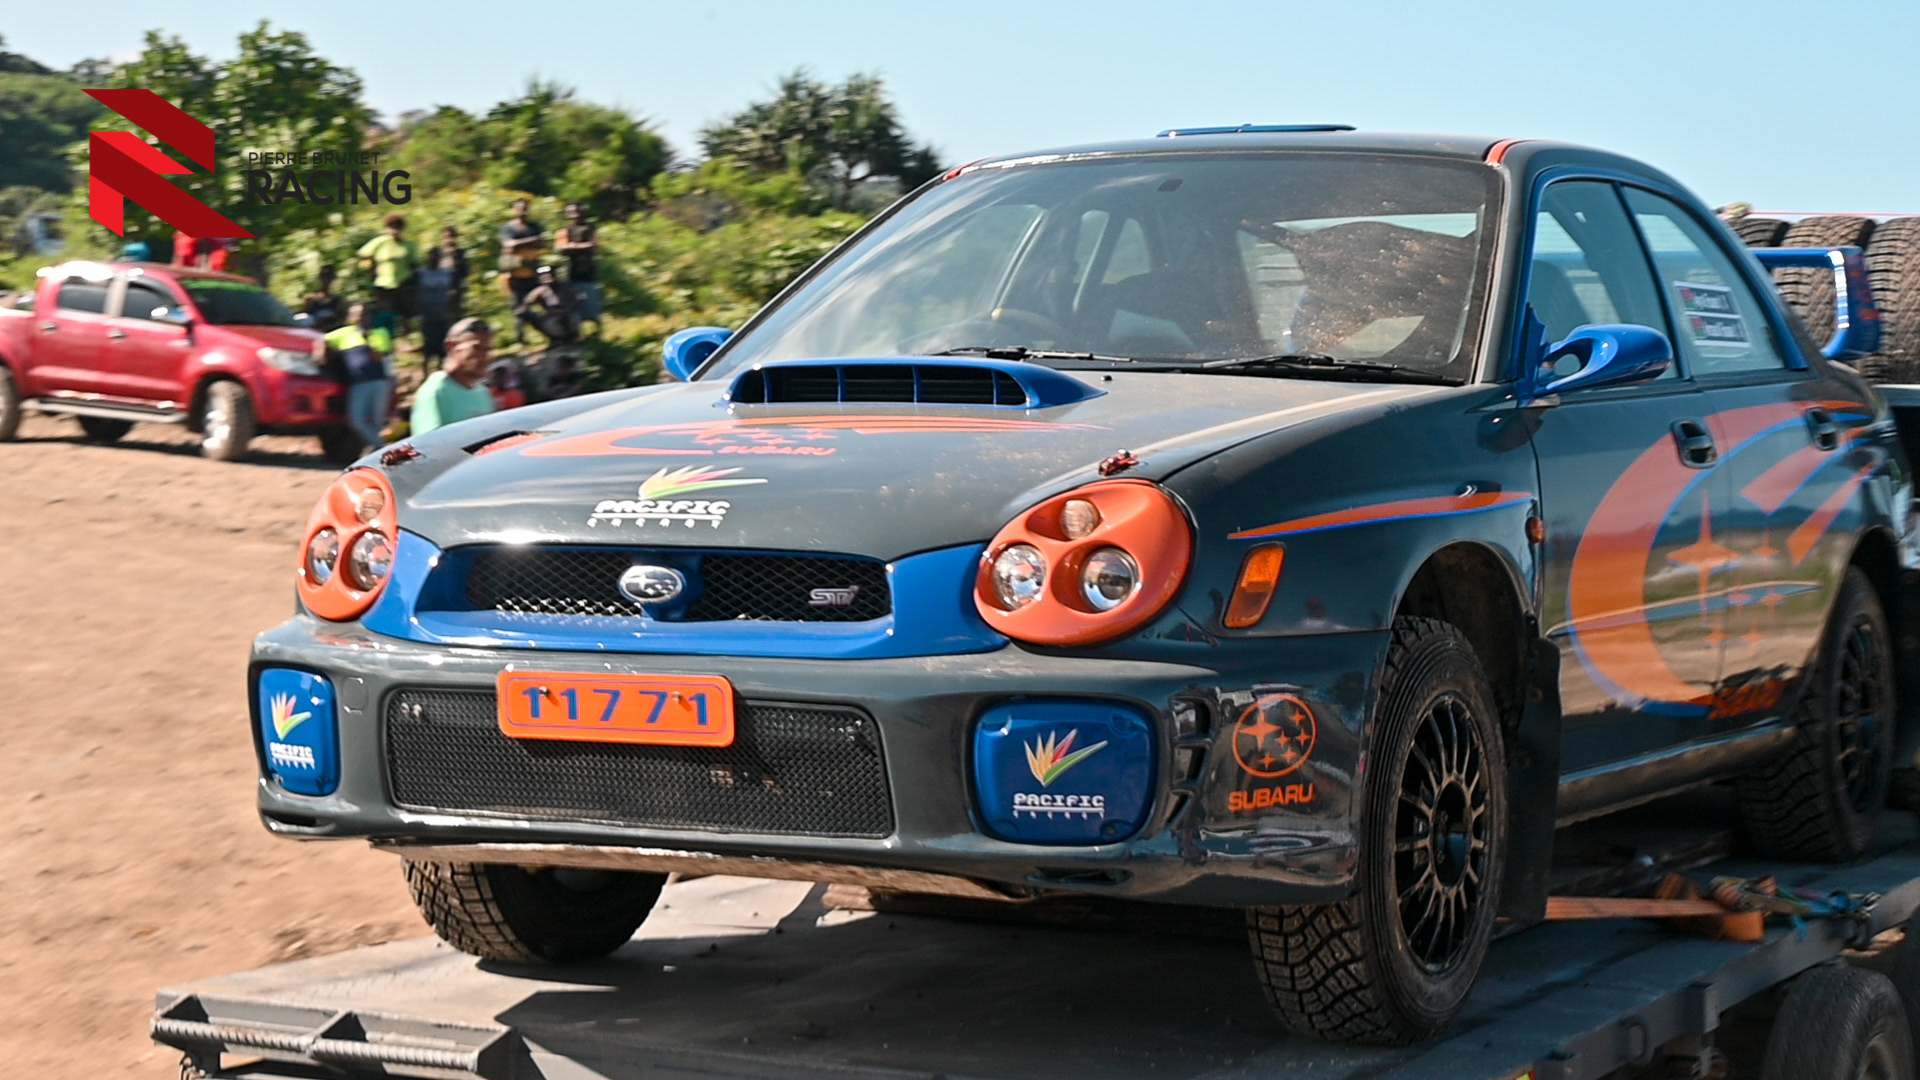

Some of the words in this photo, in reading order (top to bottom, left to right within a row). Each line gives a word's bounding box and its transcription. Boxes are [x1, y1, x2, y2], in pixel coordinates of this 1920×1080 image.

[594, 499, 731, 515] PACIFIC
[522, 686, 708, 726] 11771
[1013, 792, 1105, 807] PACIFIC
[1228, 782, 1314, 813] SUBARU
